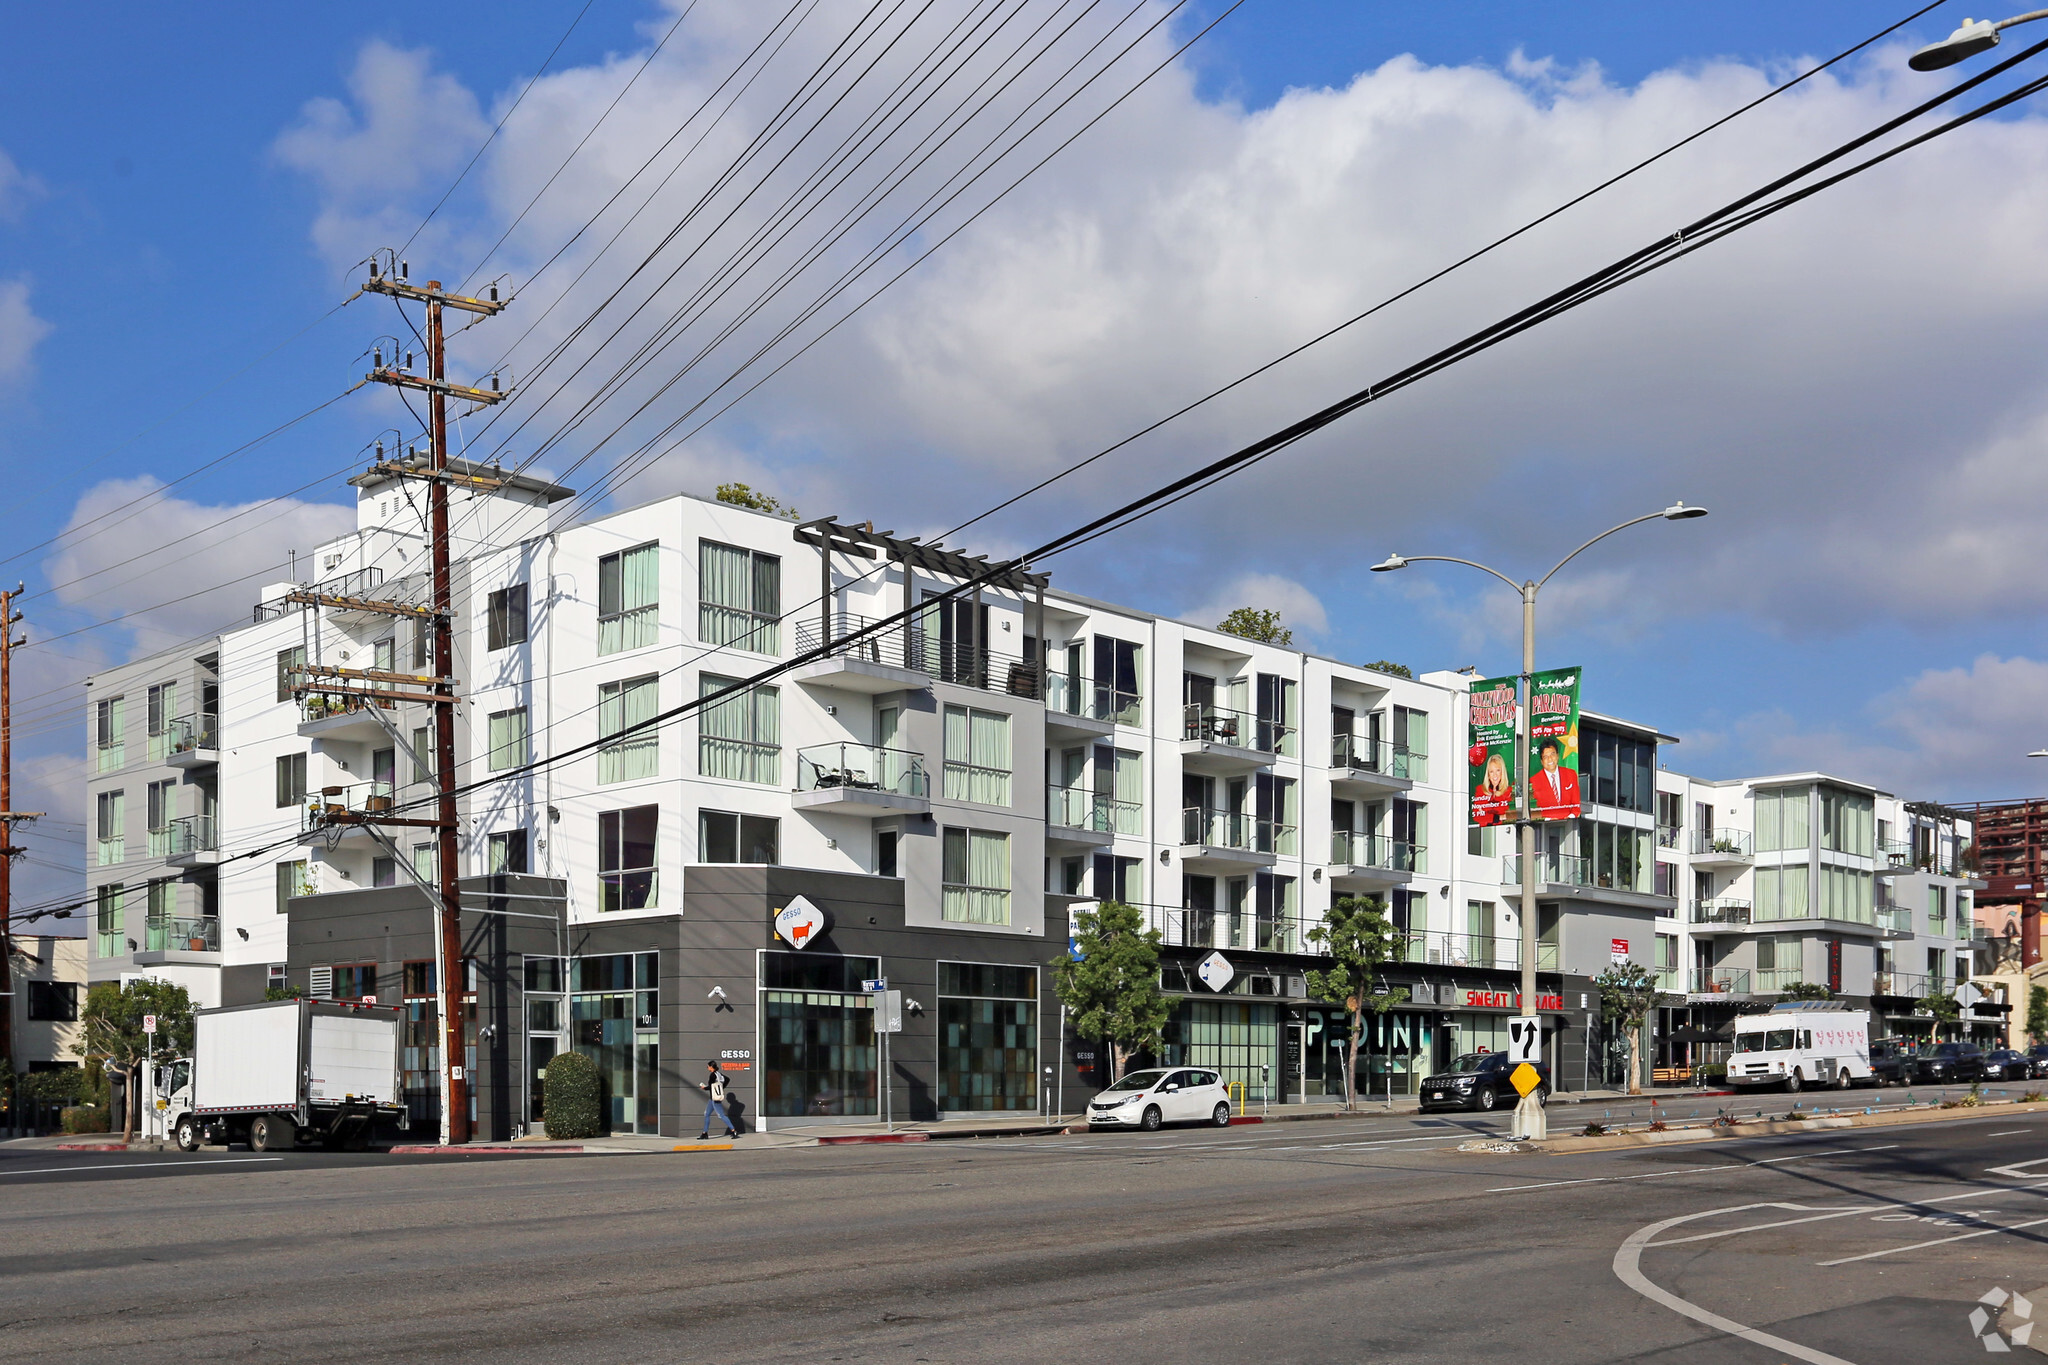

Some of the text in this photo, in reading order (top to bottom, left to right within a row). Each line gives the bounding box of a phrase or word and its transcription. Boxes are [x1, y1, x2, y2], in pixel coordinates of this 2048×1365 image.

[1470, 688, 1515, 707] HOLLYWOOD
[1532, 692, 1571, 716] PARADE
[1470, 700, 1516, 725] CHRISTMAS
[782, 907, 801, 920] GESSO
[1467, 992, 1563, 1010] SWEAT GRAGE
[642, 1014, 652, 1024] 101
[1307, 1011, 1424, 1048] PEDINI
[721, 1050, 750, 1058] GESSO
